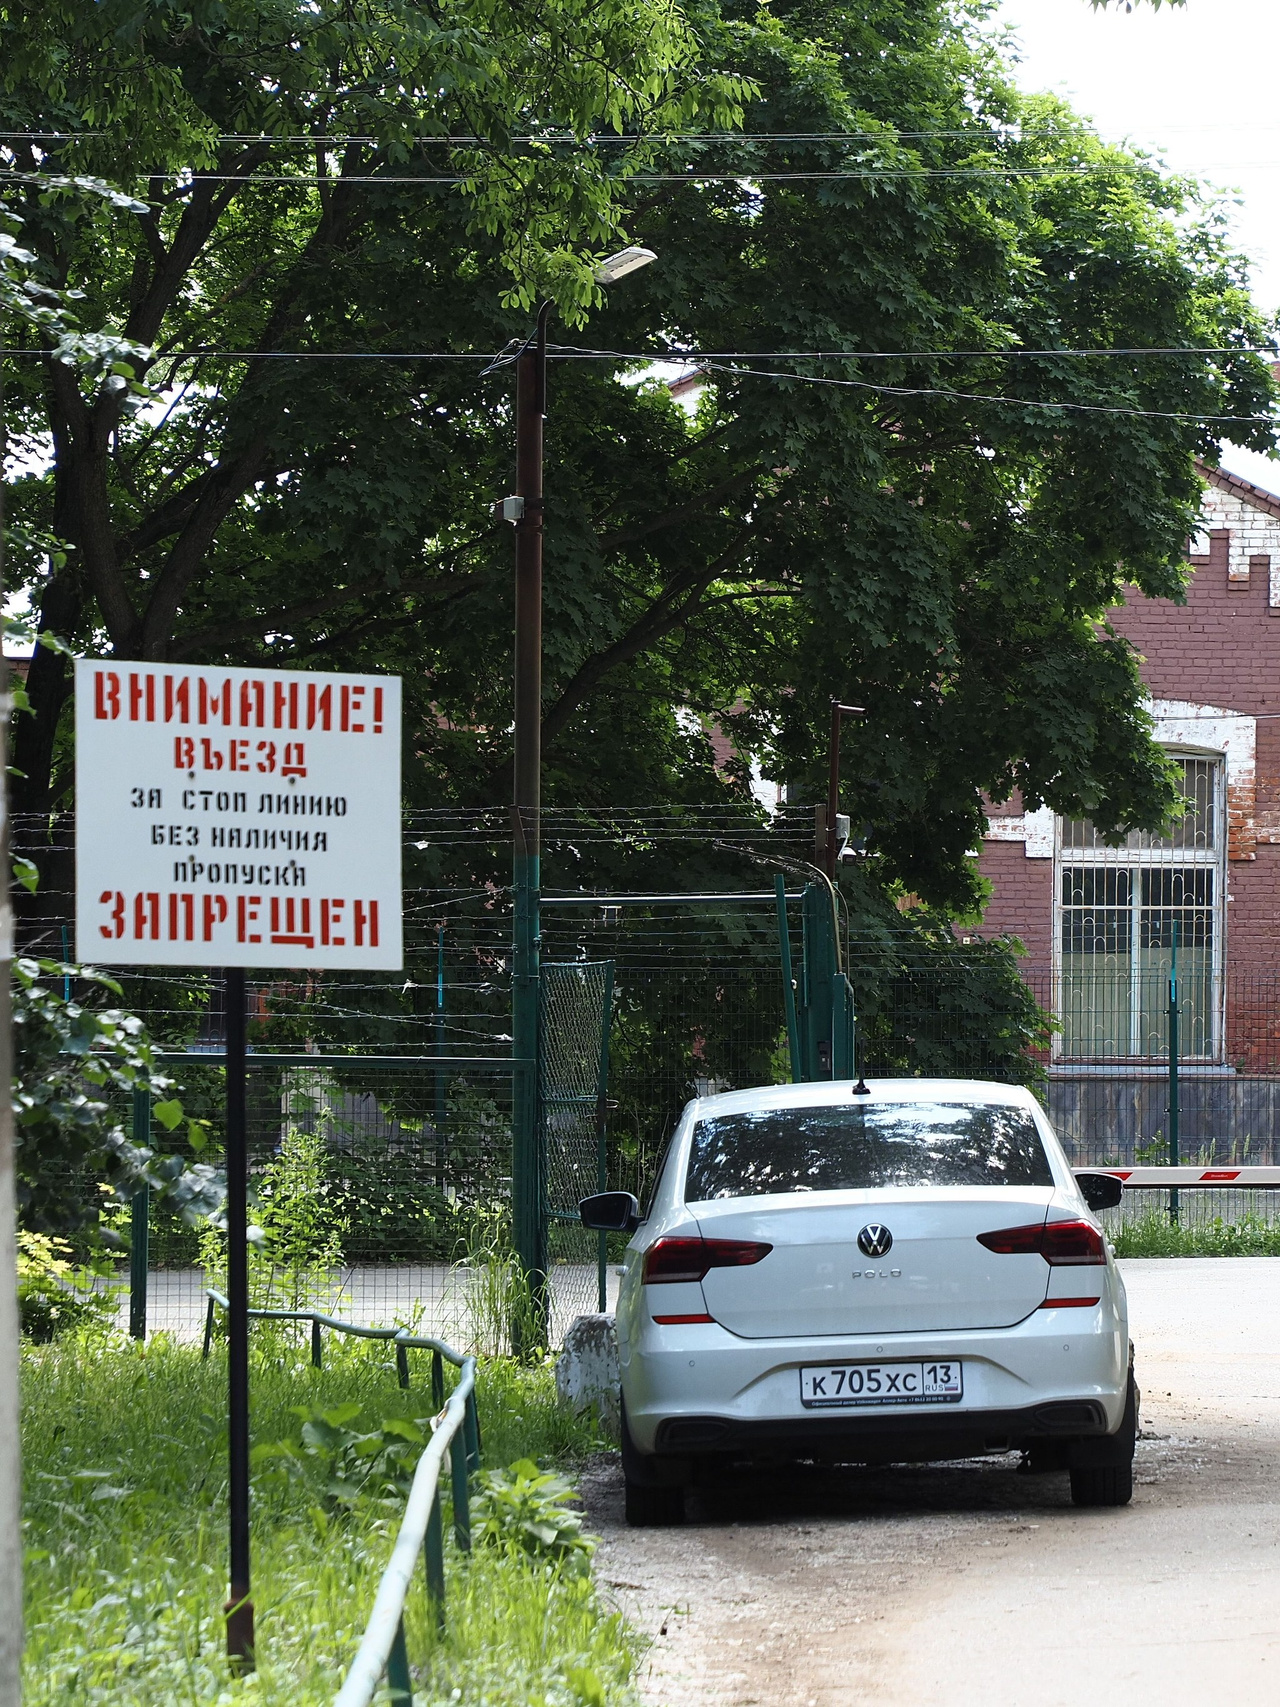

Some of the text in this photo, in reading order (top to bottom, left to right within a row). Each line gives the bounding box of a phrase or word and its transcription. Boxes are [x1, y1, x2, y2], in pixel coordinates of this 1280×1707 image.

[94, 671, 383, 734] ВНИМАНИЕ!
[174, 737, 307, 778] ВЪЕЗД
[130, 787, 347, 817] ЗА СТОП ЛИНИЮ
[151, 824, 328, 852] БЕЗ НАЛИЧИЯ
[173, 861, 306, 887] ПРОПУСКА
[98, 890, 379, 949] ЗАПРЕЩЕН
[852, 1268, 902, 1279] POLO
[925, 1384, 945, 1392] RUS
[927, 1365, 952, 1385] 13
